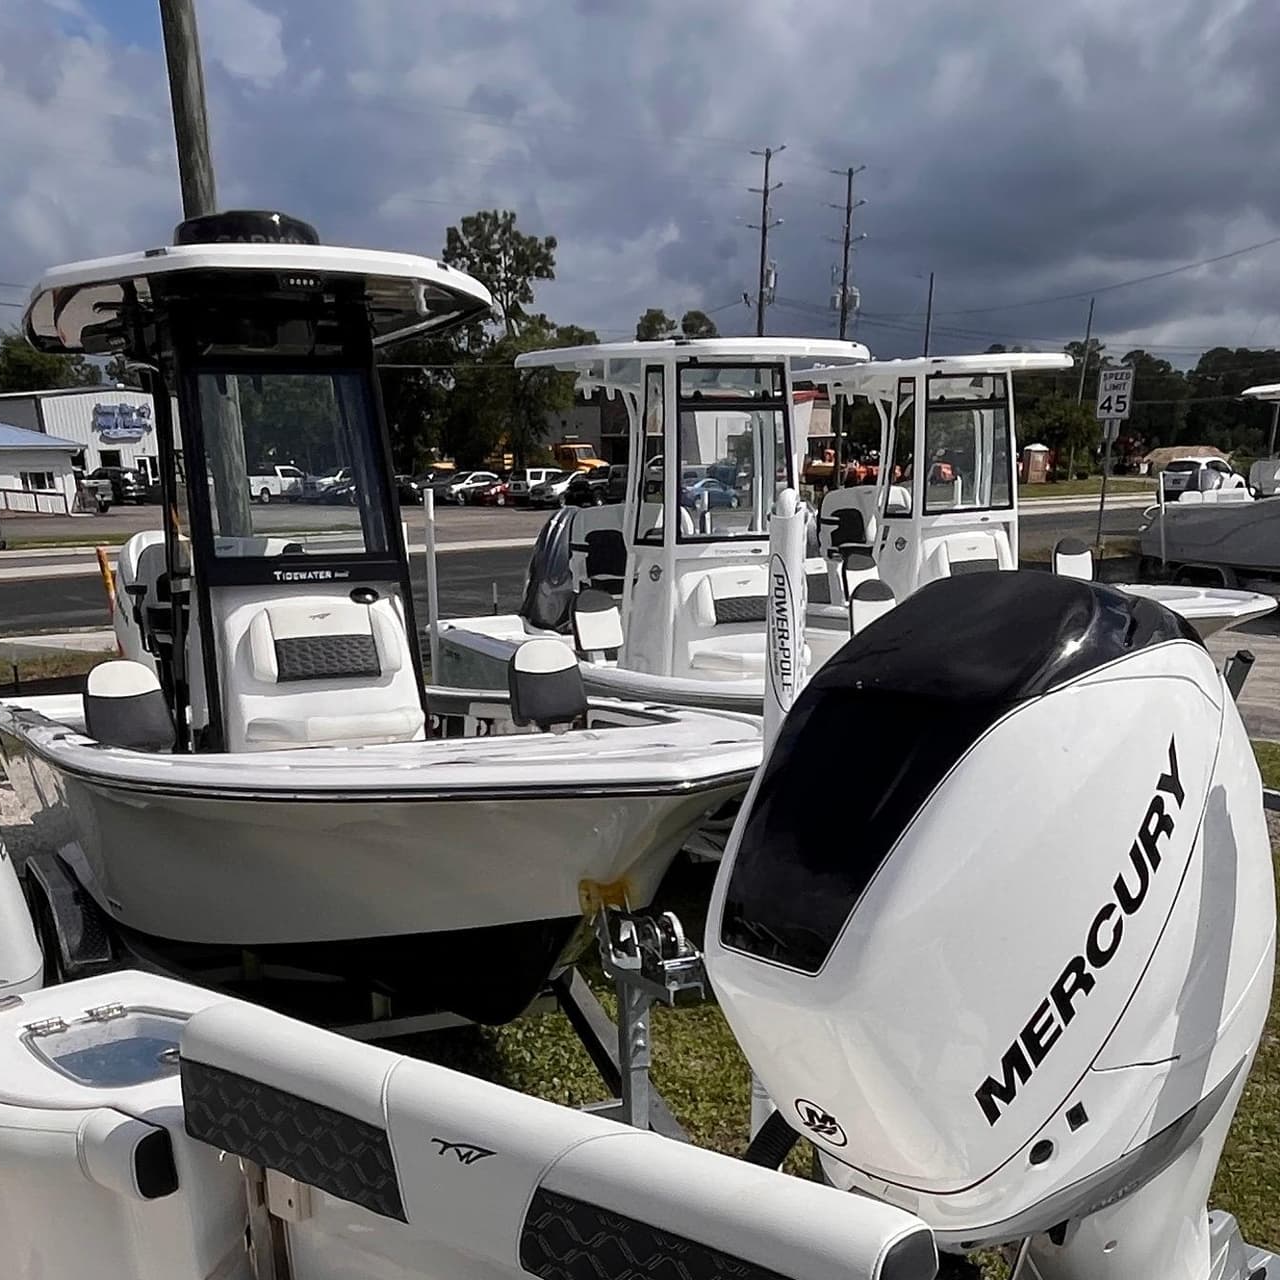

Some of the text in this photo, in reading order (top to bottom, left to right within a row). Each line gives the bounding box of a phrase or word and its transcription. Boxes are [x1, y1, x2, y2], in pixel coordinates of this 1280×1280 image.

[1103, 372, 1131, 380] SPEED
[1105, 383, 1127, 391] LIMIT
[1100, 395, 1127, 413] 45
[773, 573, 792, 693] POWER-POLE
[974, 733, 1188, 1127] MERCURY
